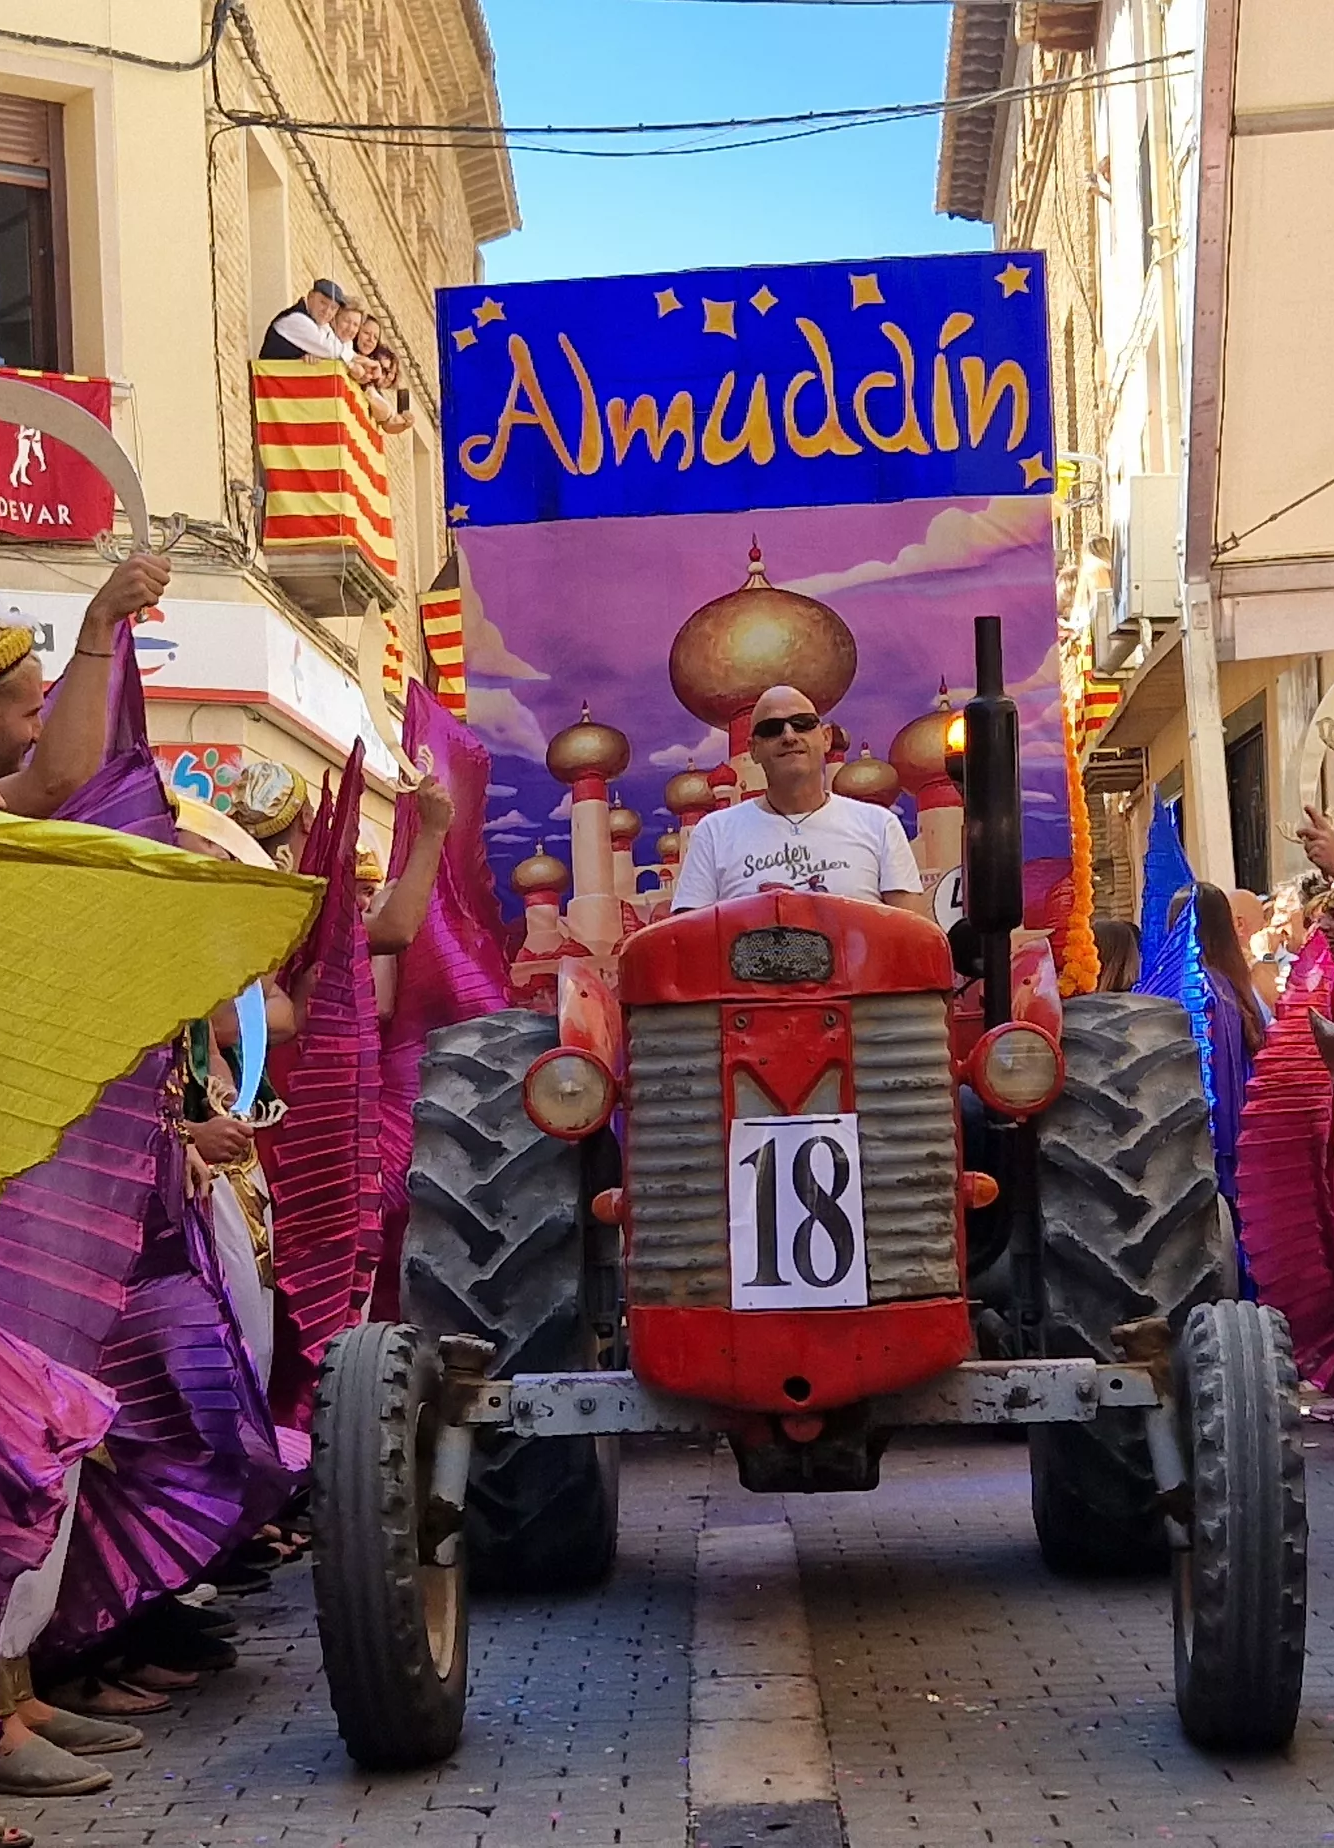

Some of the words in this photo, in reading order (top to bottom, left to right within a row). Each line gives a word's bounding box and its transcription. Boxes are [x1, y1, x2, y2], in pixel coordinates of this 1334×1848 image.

[459, 312, 1029, 482] Almuddín
[743, 842, 811, 878] Scooter
[785, 859, 851, 880] Rider
[739, 1135, 855, 1288] 18
